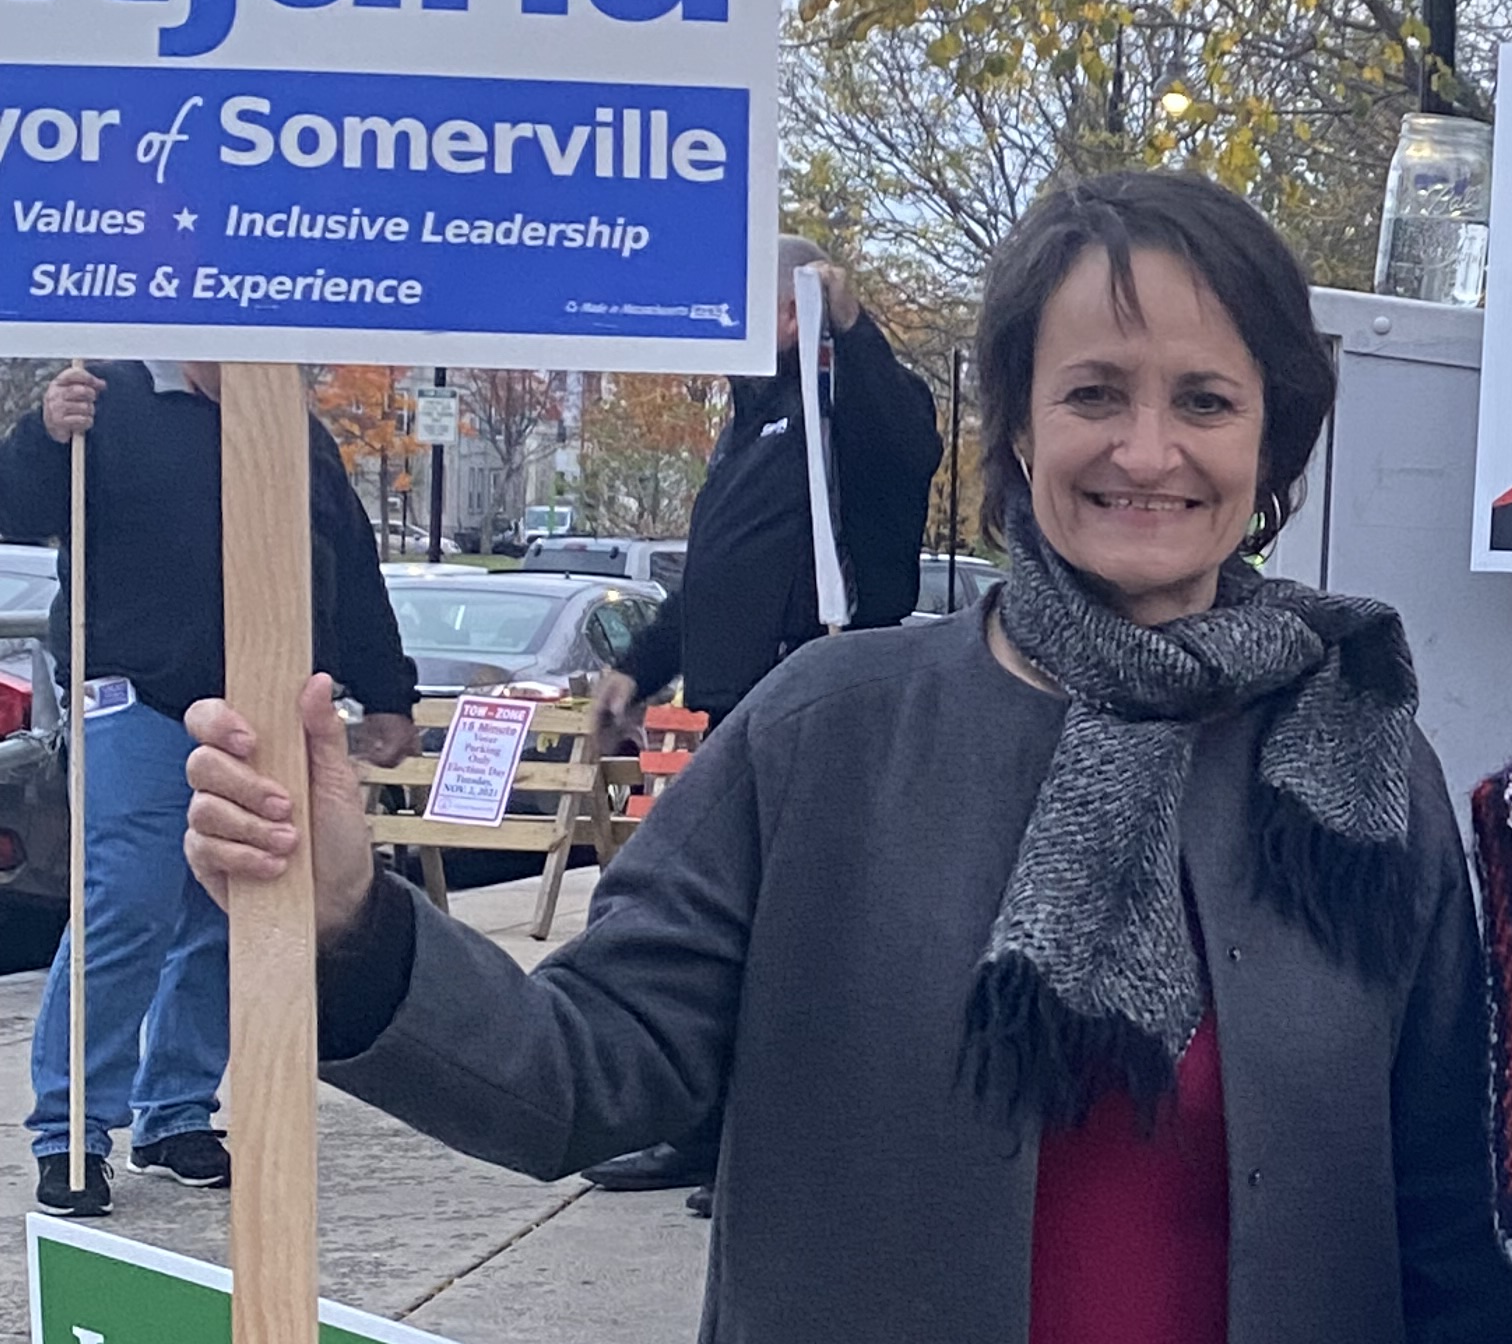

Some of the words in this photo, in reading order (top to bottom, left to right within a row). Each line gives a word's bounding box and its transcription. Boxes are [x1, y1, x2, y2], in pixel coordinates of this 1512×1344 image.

[136, 95, 204, 183] of
[219, 95, 727, 183] Somerville
[13, 201, 145, 235] Values
[225, 205, 410, 243] Inclusive
[421, 211, 651, 258] Leadership
[29, 265, 137, 299] Skills
[148, 268, 179, 299] &
[192, 268, 423, 308] Experience
[463, 704, 488, 717] TOW
[495, 707, 526, 720] ZONE
